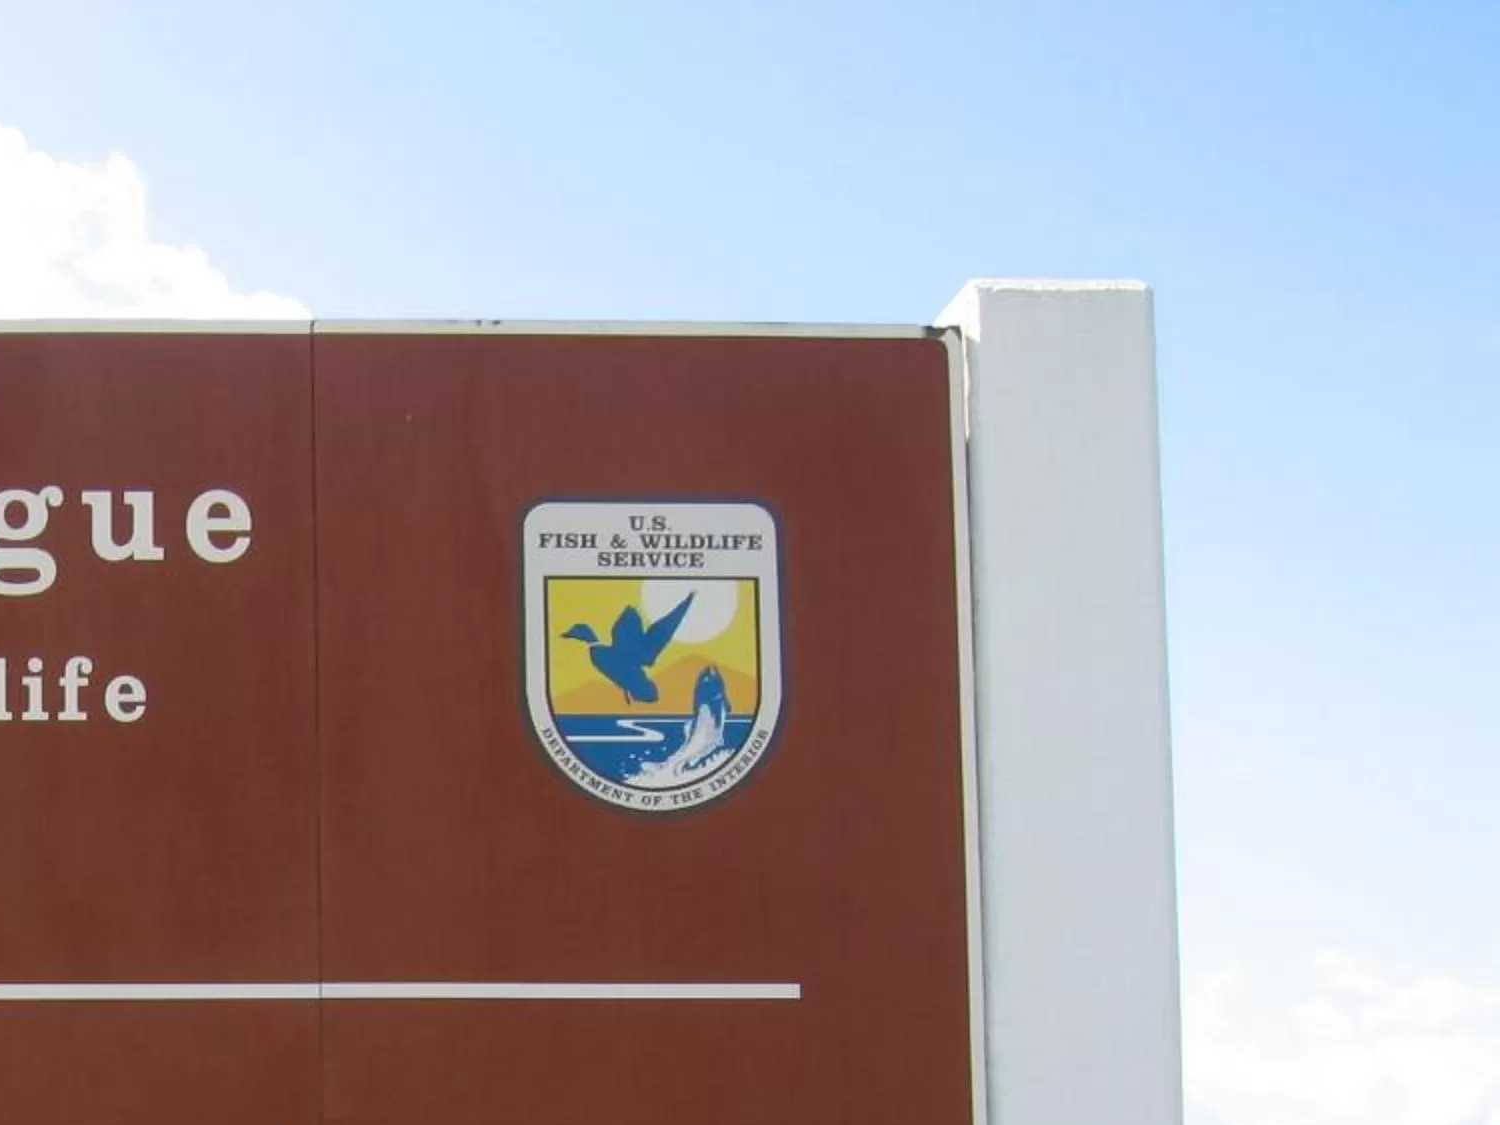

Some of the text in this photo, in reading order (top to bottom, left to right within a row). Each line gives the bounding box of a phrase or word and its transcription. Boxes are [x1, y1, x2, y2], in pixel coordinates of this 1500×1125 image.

[628, 515, 672, 531] U.S.
[539, 533, 764, 550] FISH & WILDLIFE
[597, 552, 705, 568] SERVICE
[542, 726, 769, 807] DEPARTMENT OF THE INTERIOR
